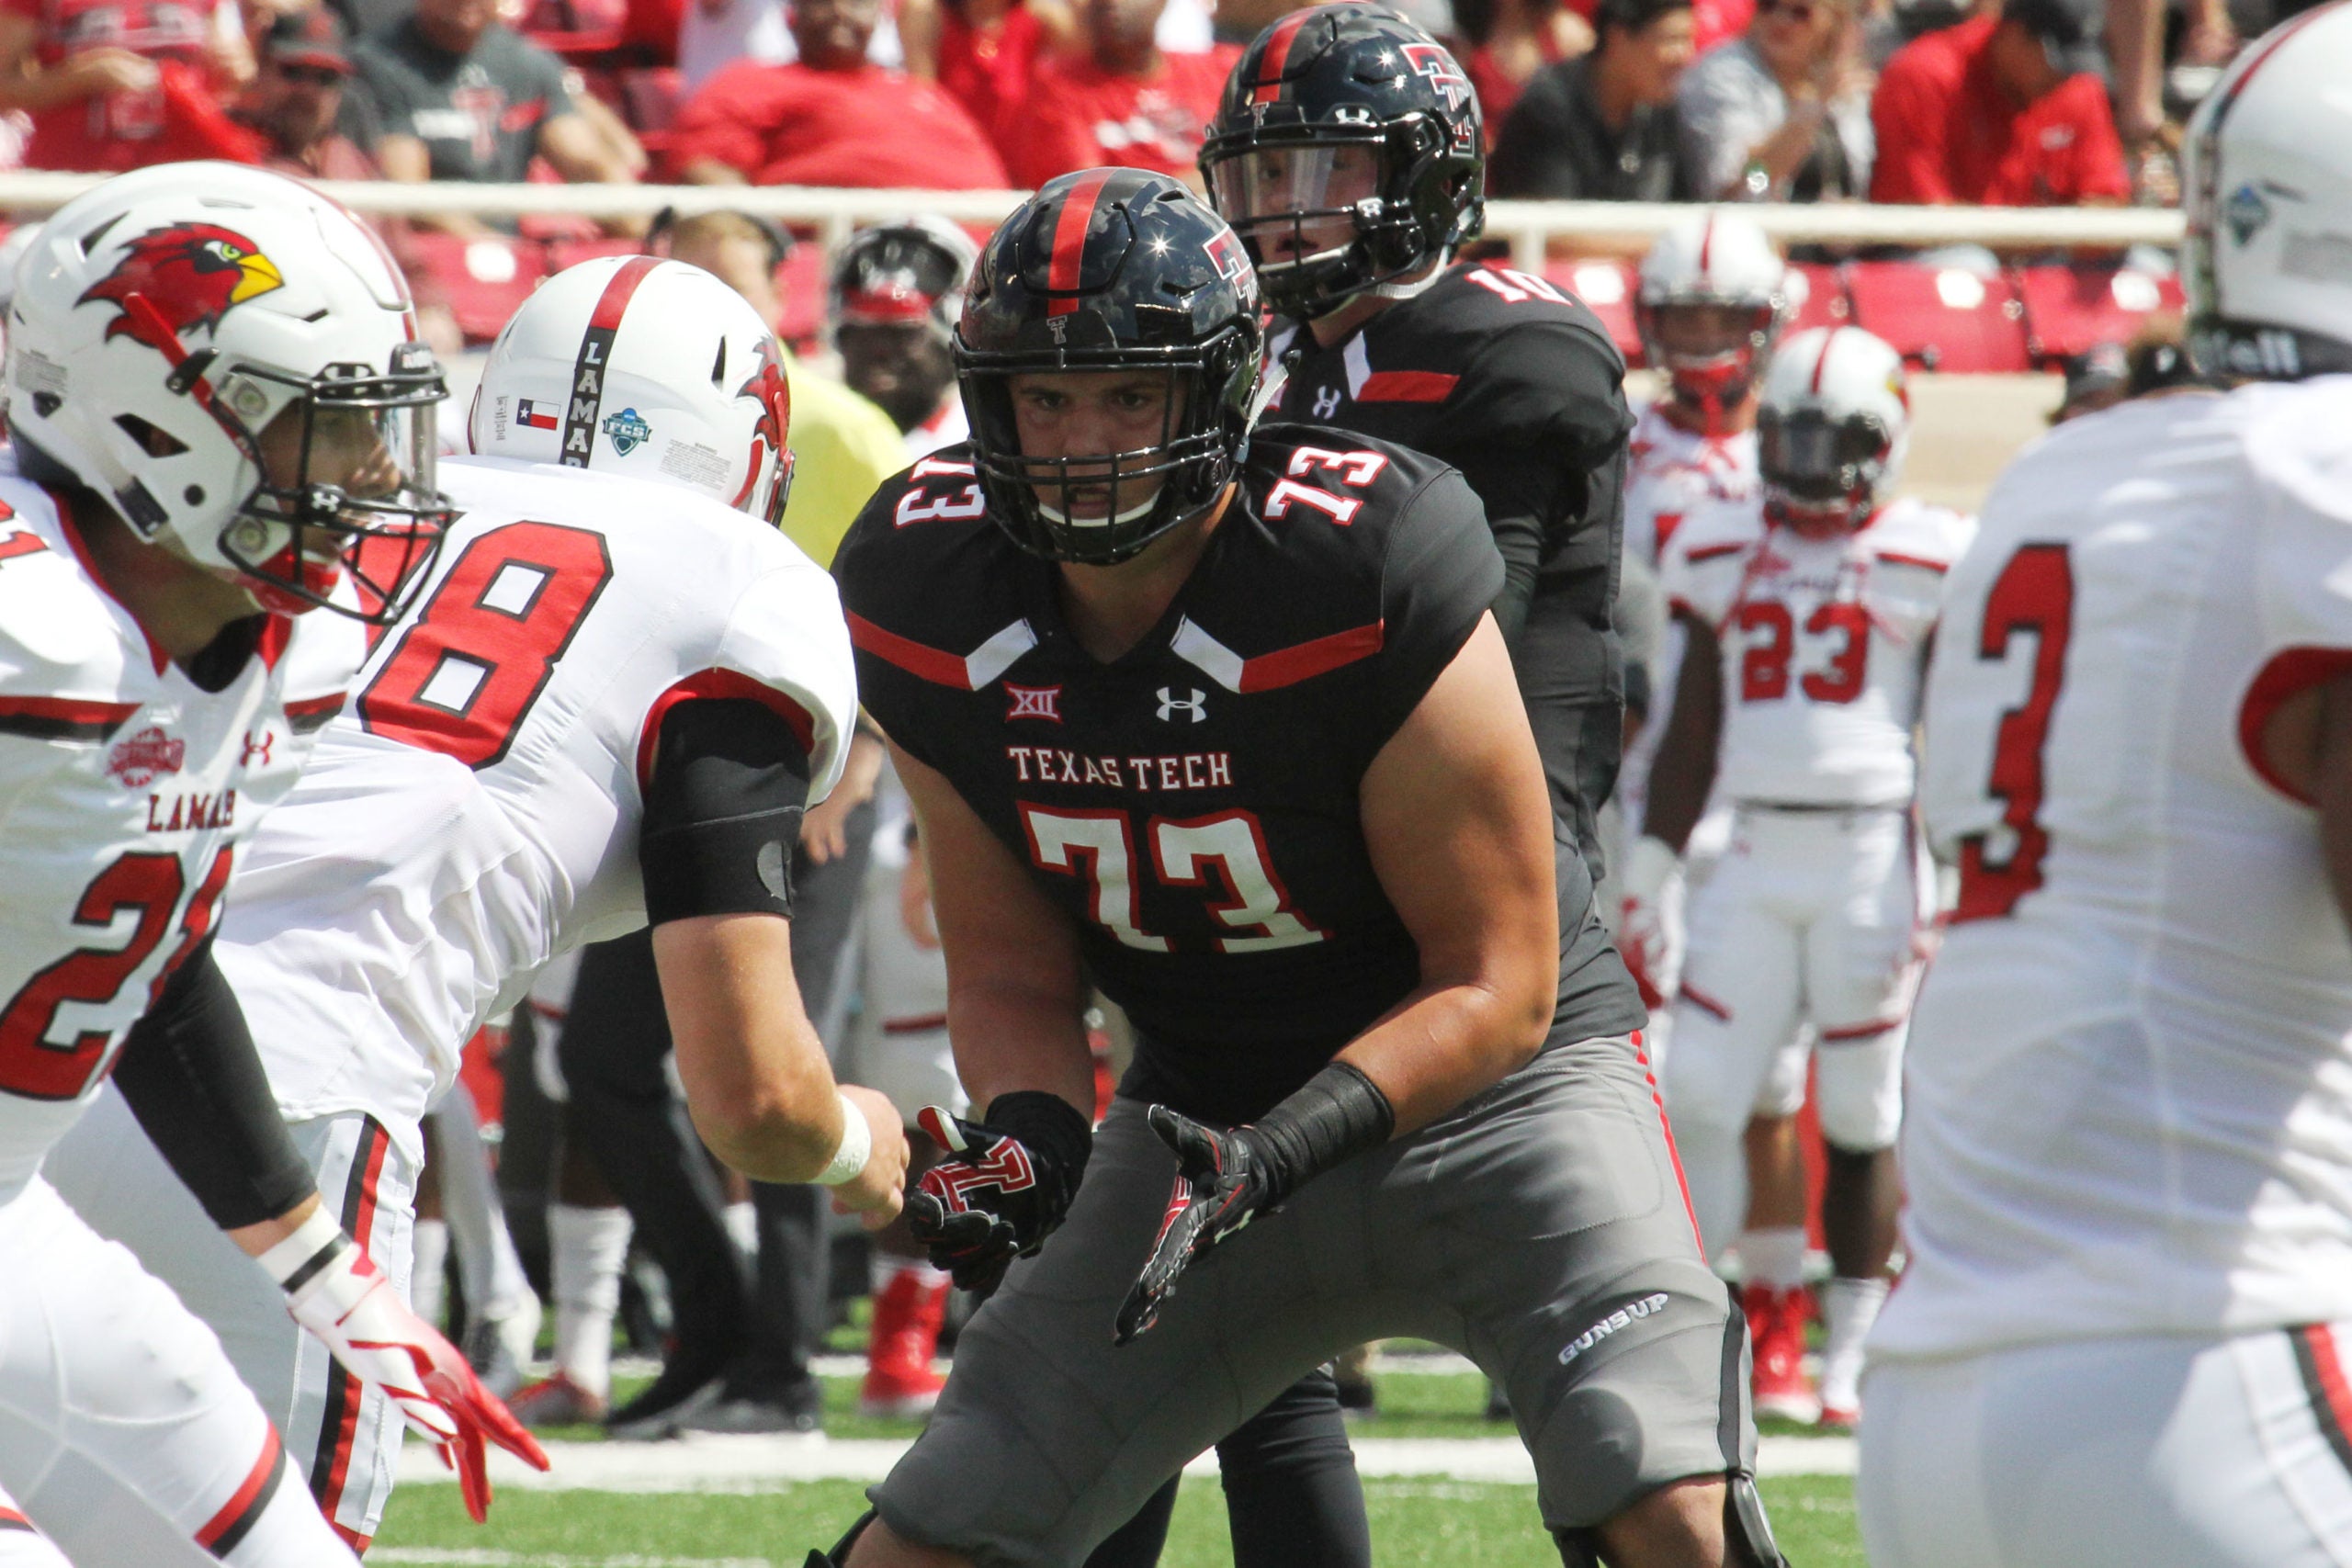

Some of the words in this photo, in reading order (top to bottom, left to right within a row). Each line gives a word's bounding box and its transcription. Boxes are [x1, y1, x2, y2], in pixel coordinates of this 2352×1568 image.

[1261, 444, 1389, 526] 73
[1740, 601, 1870, 705] 23
[1007, 744, 1125, 788] TEXAS
[1128, 750, 1233, 792] TECH
[1016, 799, 1334, 954] 73
